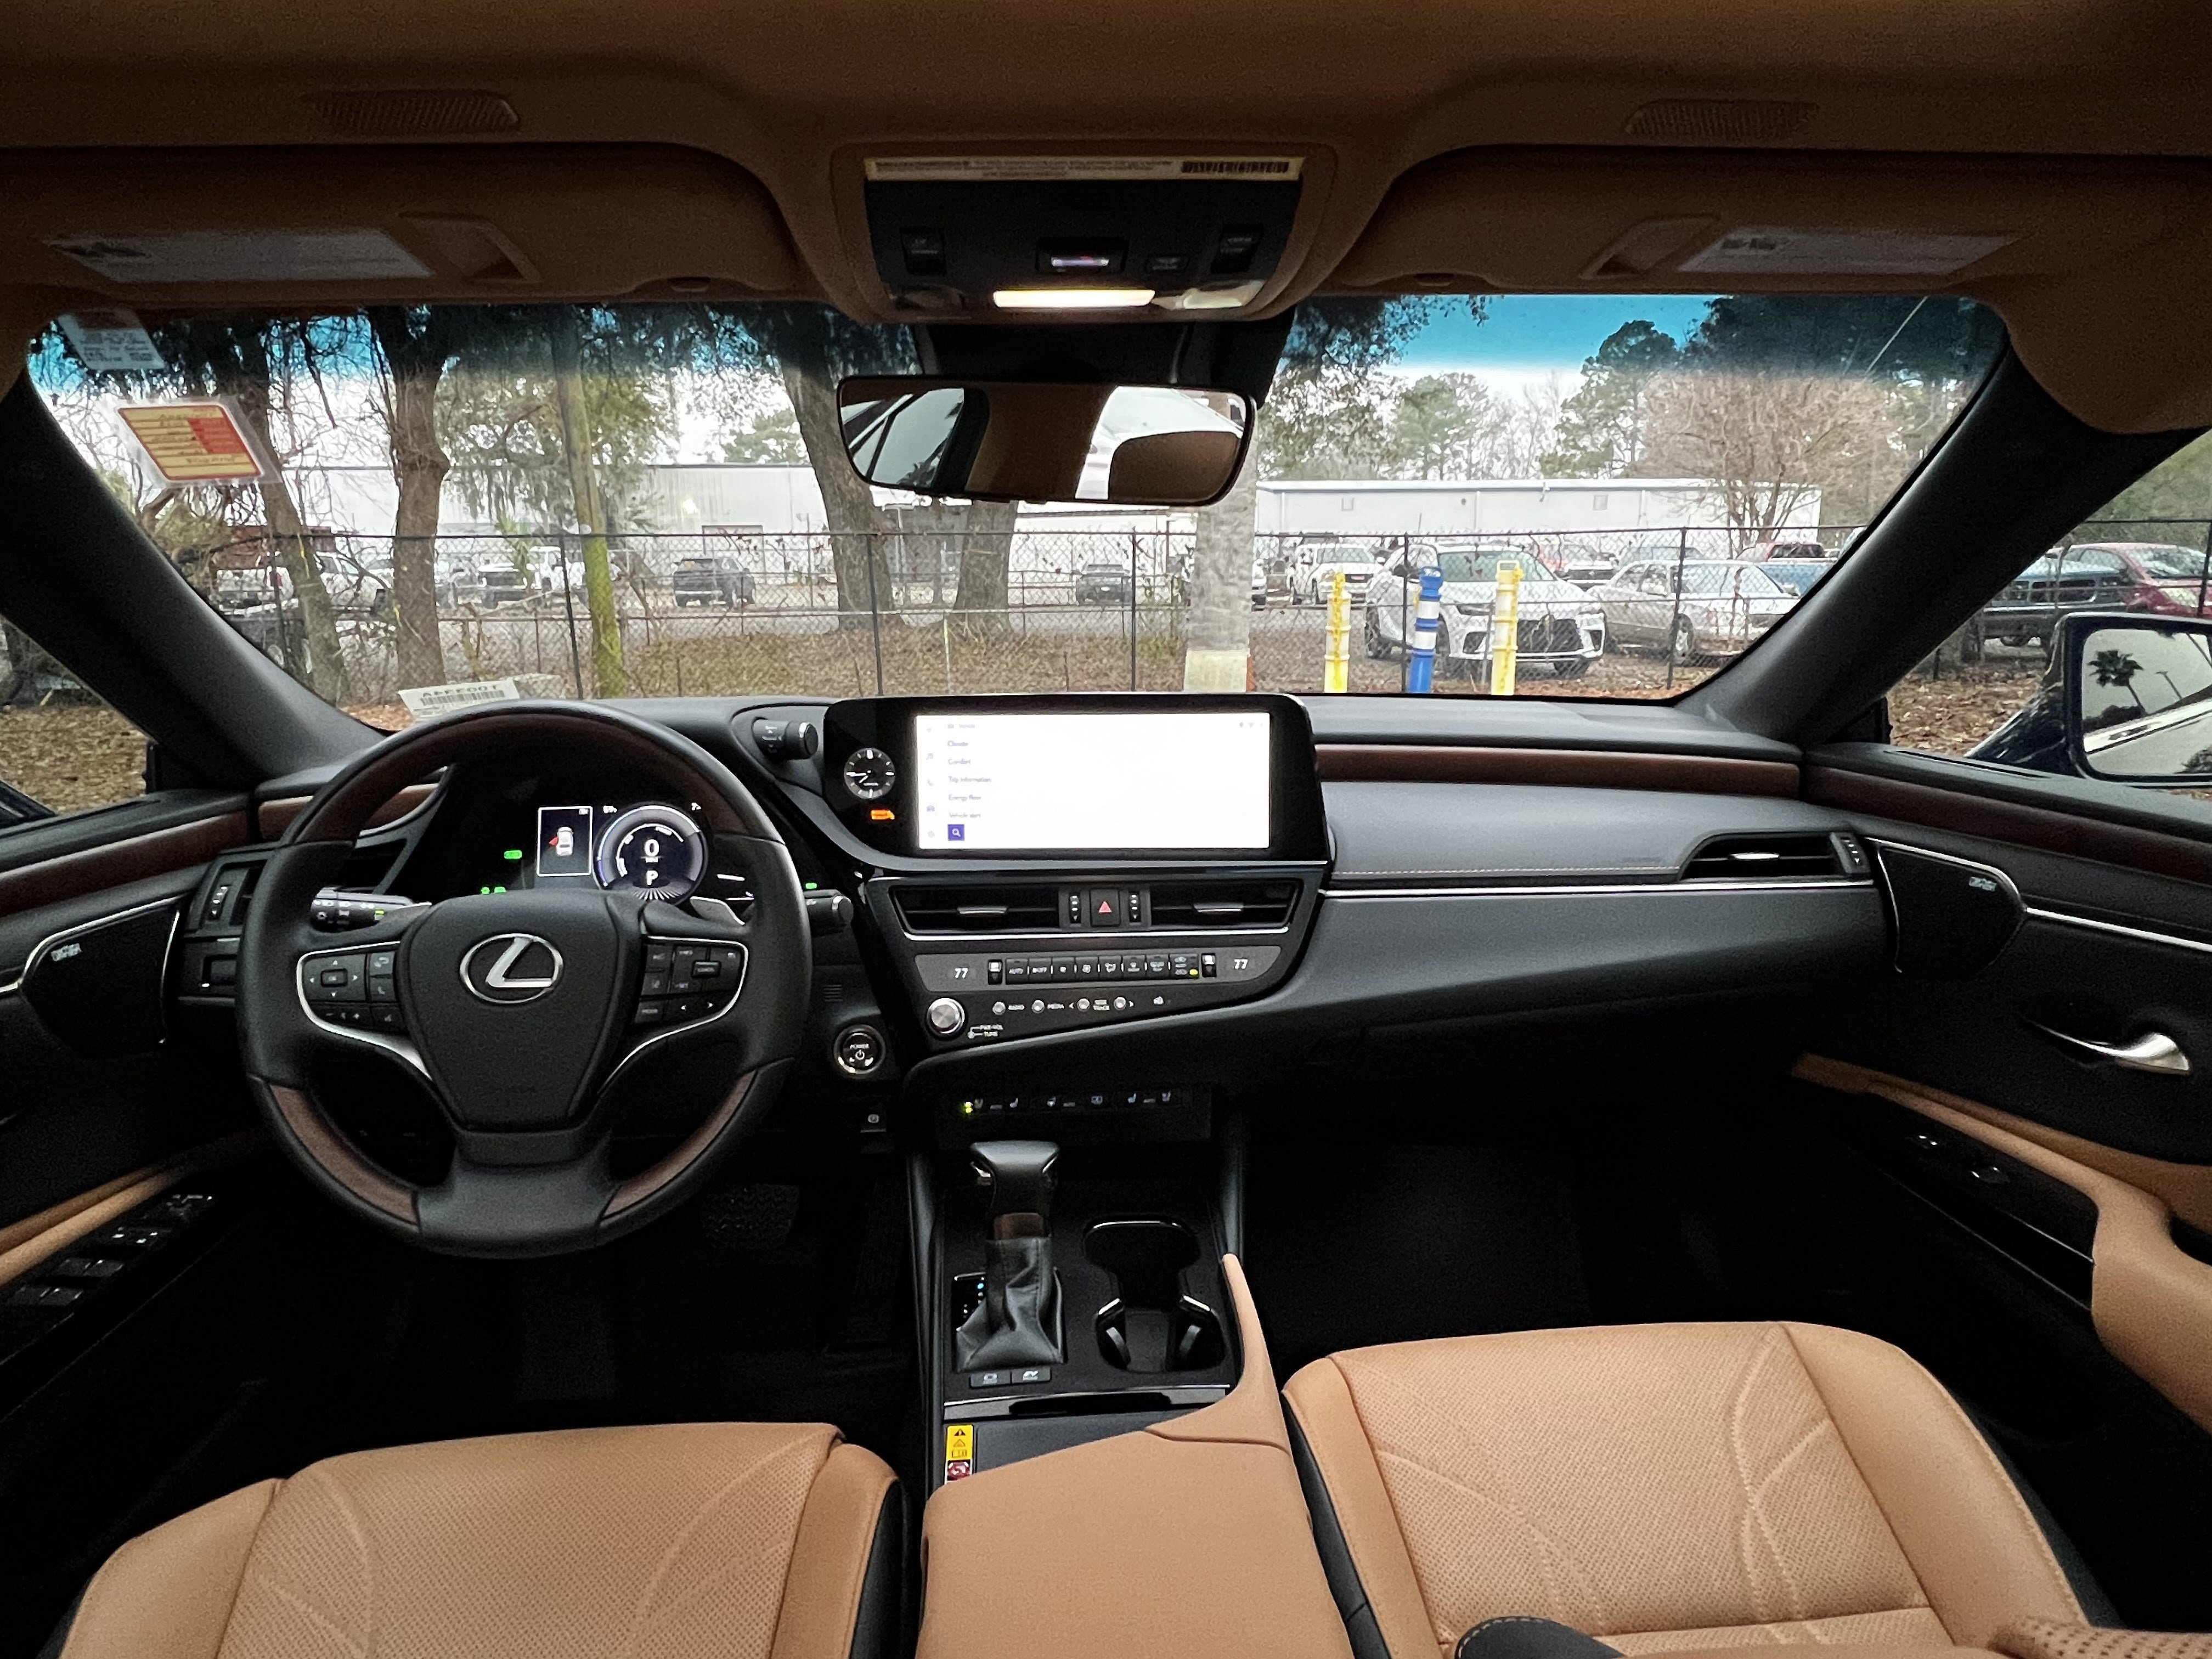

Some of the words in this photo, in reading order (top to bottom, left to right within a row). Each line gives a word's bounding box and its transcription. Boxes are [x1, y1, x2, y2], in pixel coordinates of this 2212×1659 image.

[645, 870, 658, 885] P
[1233, 958, 1249, 969] 77
[954, 967, 969, 979] 77
